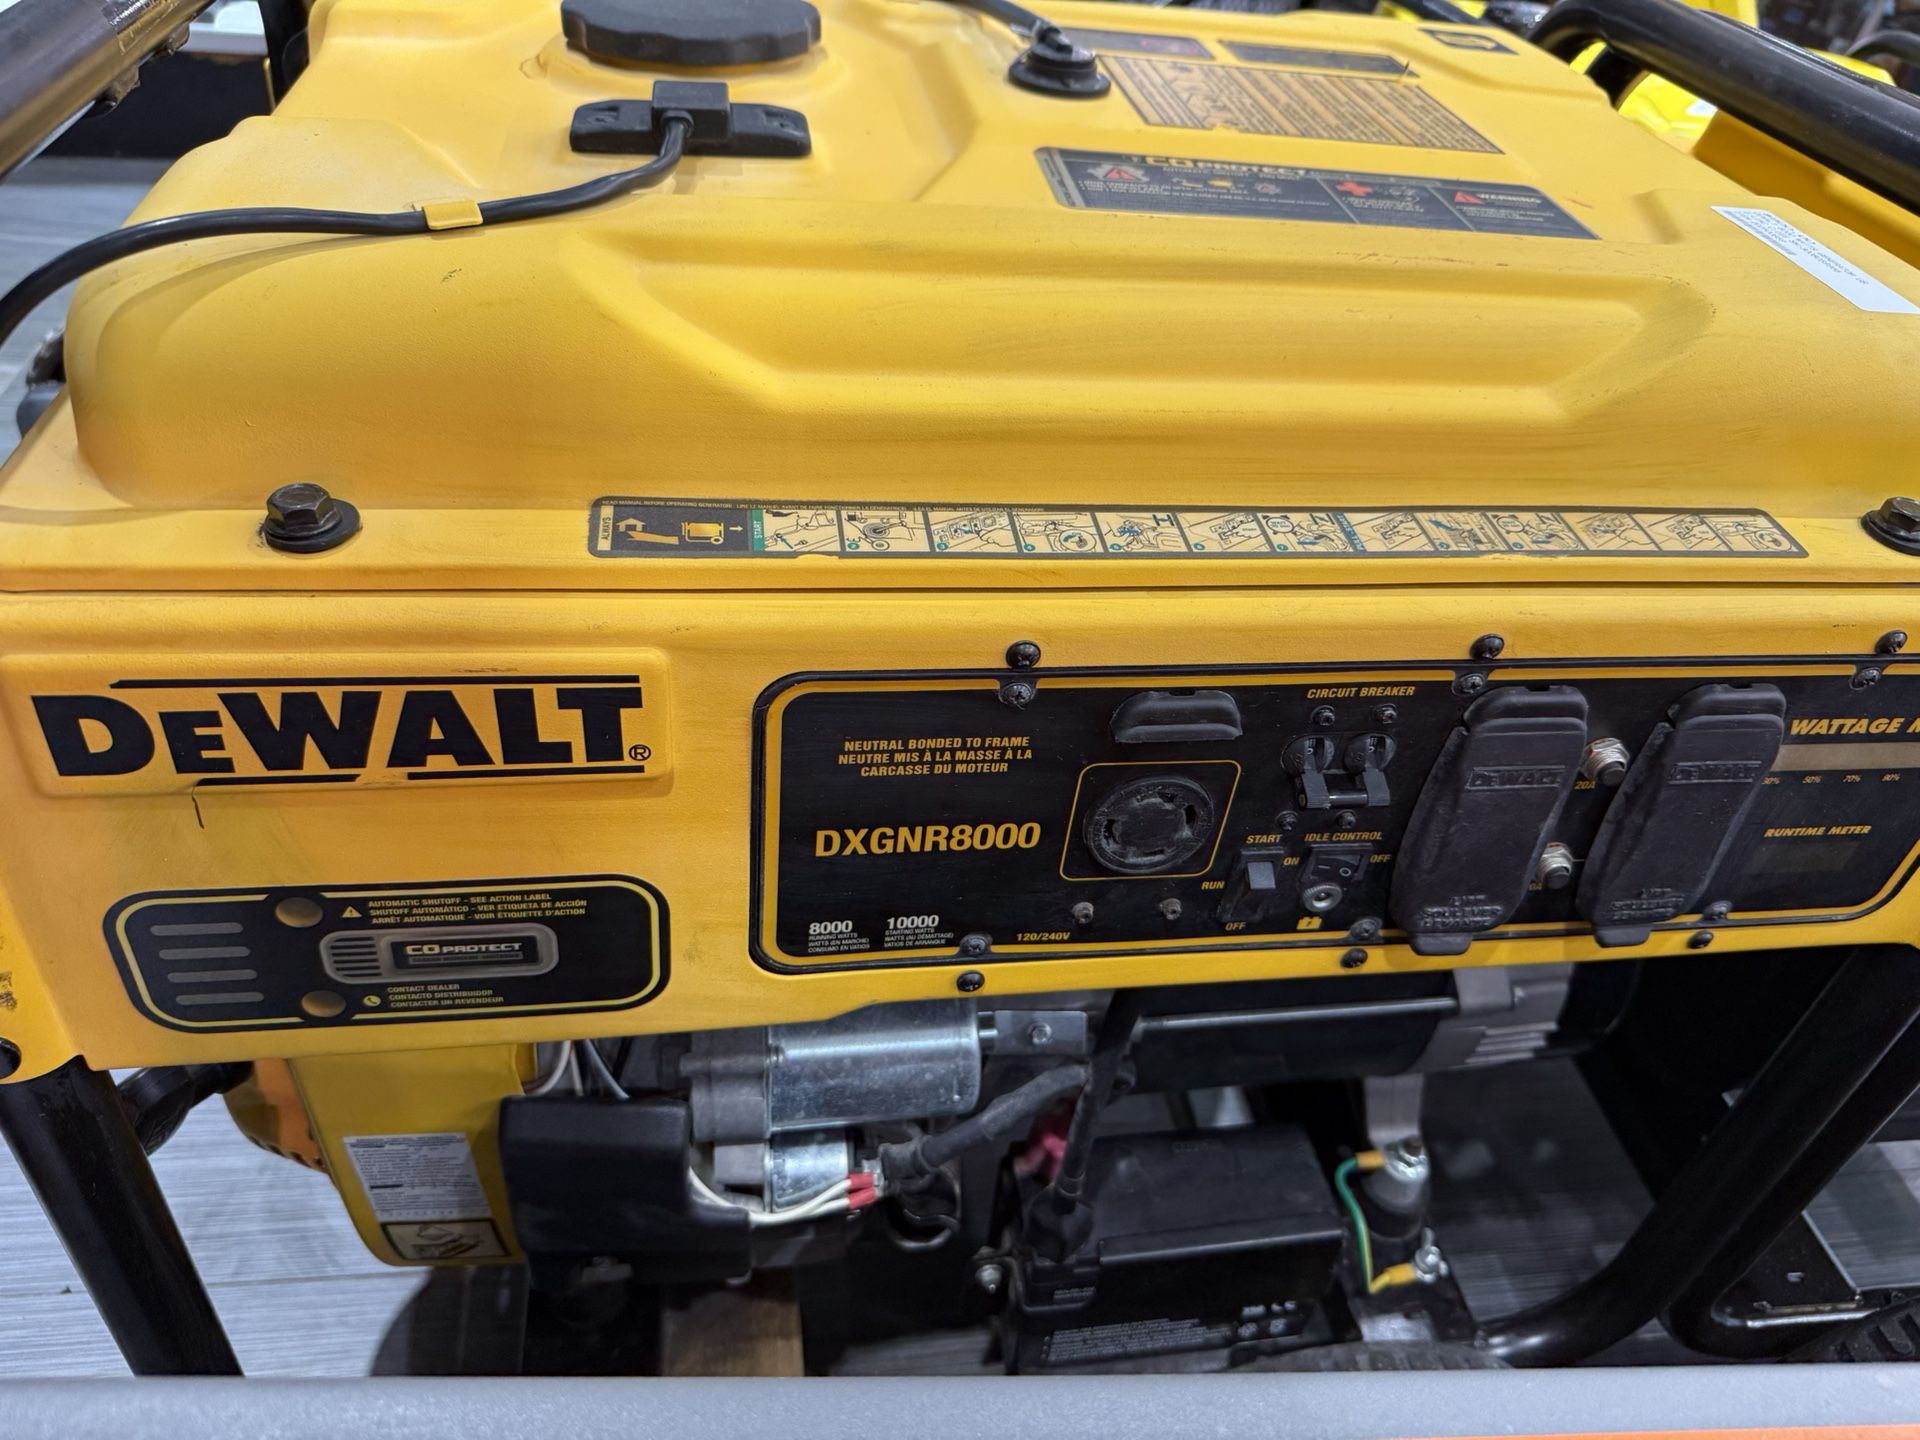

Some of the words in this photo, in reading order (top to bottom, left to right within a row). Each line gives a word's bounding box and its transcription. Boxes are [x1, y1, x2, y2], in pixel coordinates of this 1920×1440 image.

[754, 521, 763, 539] START
[1307, 688, 1358, 699] CIRCUIT
[1360, 686, 1416, 697] BREAKER
[1790, 718, 1905, 736] WATTAGE
[844, 739, 904, 752] NEUTRAL
[908, 738, 962, 749] BONDED
[966, 737, 981, 749] TO
[985, 736, 1030, 748] FRAME
[838, 753, 890, 765] NEUTRE
[894, 752, 919, 763] MIS
[923, 749, 932, 762] À
[936, 751, 951, 762] LA
[955, 750, 1001, 761] MASSE
[1004, 747, 1013, 760] À
[1017, 749, 1032, 760] LA
[861, 765, 930, 777] CARCASSE
[934, 764, 951, 775] DU
[955, 762, 1008, 774] MOTEUR
[1574, 781, 1596, 790] 20A
[1304, 832, 1329, 842] IDLE
[1332, 831, 1383, 842] CONTROL
[1764, 826, 1826, 838] RUNTIME
[1827, 825, 1872, 835] METER
[815, 822, 1041, 857] DXGNR8000
[1246, 833, 1283, 844] START
[1283, 856, 1300, 866] ON
[1370, 854, 1392, 863] OFF
[1201, 881, 1225, 890] RUN
[369, 899, 420, 908] AUTOMATIC
[422, 897, 461, 906] SHUTOFF
[470, 896, 487, 904] SEE
[490, 894, 522, 902] ACTION
[524, 893, 552, 901] LABEL
[369, 907, 410, 916] SHUTOFF
[412, 904, 469, 914] AUTOMÁTICO
[478, 903, 495, 911] VER
[498, 901, 539, 911] ETIQUETA
[541, 901, 553, 909] DE
[555, 899, 587, 908] ACCIÓN
[372, 914, 401, 924] ARRÊT
[403, 913, 465, 923] AUTOMATIQUE
[474, 911, 495, 920] VOIR
[545, 907, 586, 917] D'ACTION
[887, 914, 940, 930] 10000
[809, 920, 853, 935] 8000
[1225, 921, 1247, 931] OFF
[1016, 931, 1071, 942] 120/240V
[406, 943, 441, 956] CO
[442, 942, 523, 954] PROTECT
[387, 985, 425, 993] CONTACT
[427, 983, 460, 991] DEALER
[389, 992, 432, 1001] CONTACTO
[434, 989, 493, 999] DISTRIBUIDOR
[390, 999, 439, 1008] CONTACTER
[455, 996, 504, 1005] REVENDEUR
